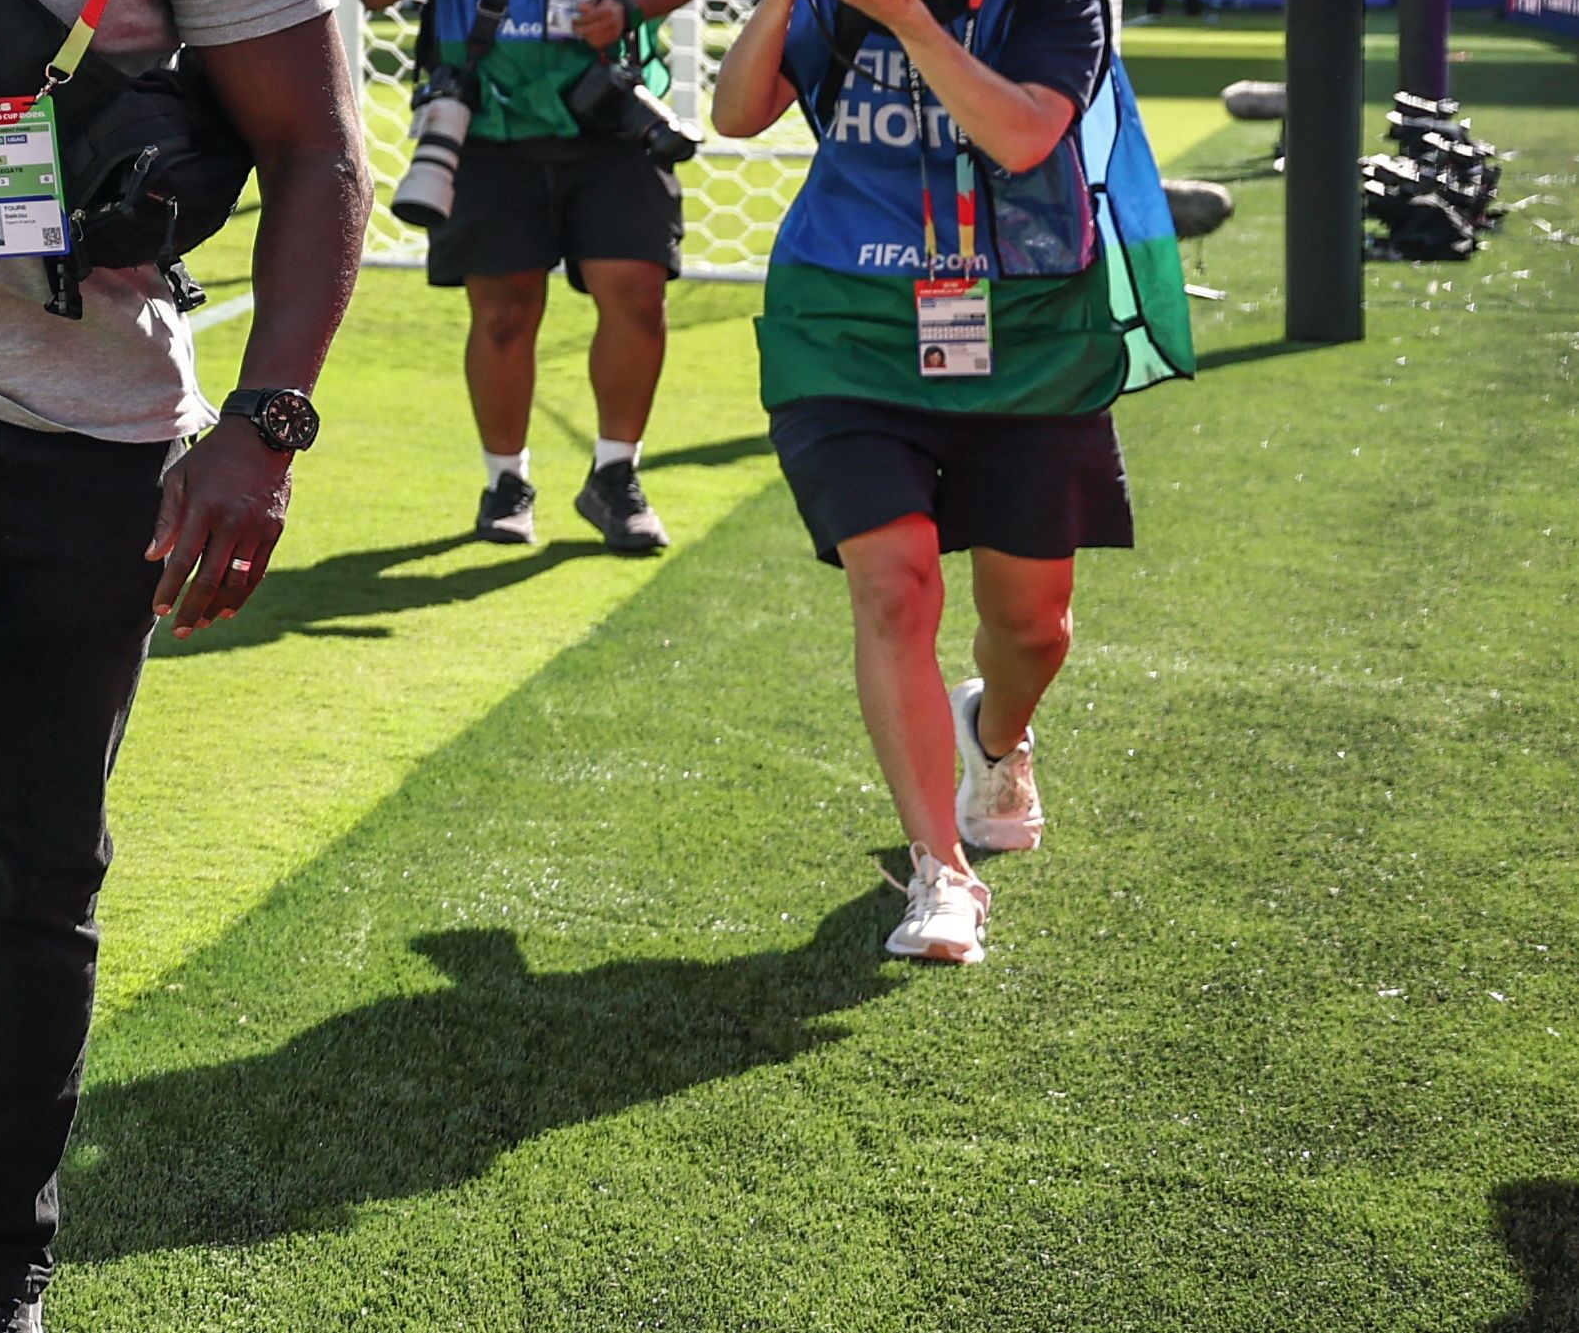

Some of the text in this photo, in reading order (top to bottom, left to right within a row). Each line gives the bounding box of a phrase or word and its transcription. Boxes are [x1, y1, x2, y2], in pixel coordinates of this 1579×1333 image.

[3, 111, 18, 120] CUP
[19, 111, 45, 119] 2026
[858, 243, 989, 270] FIFA.com
